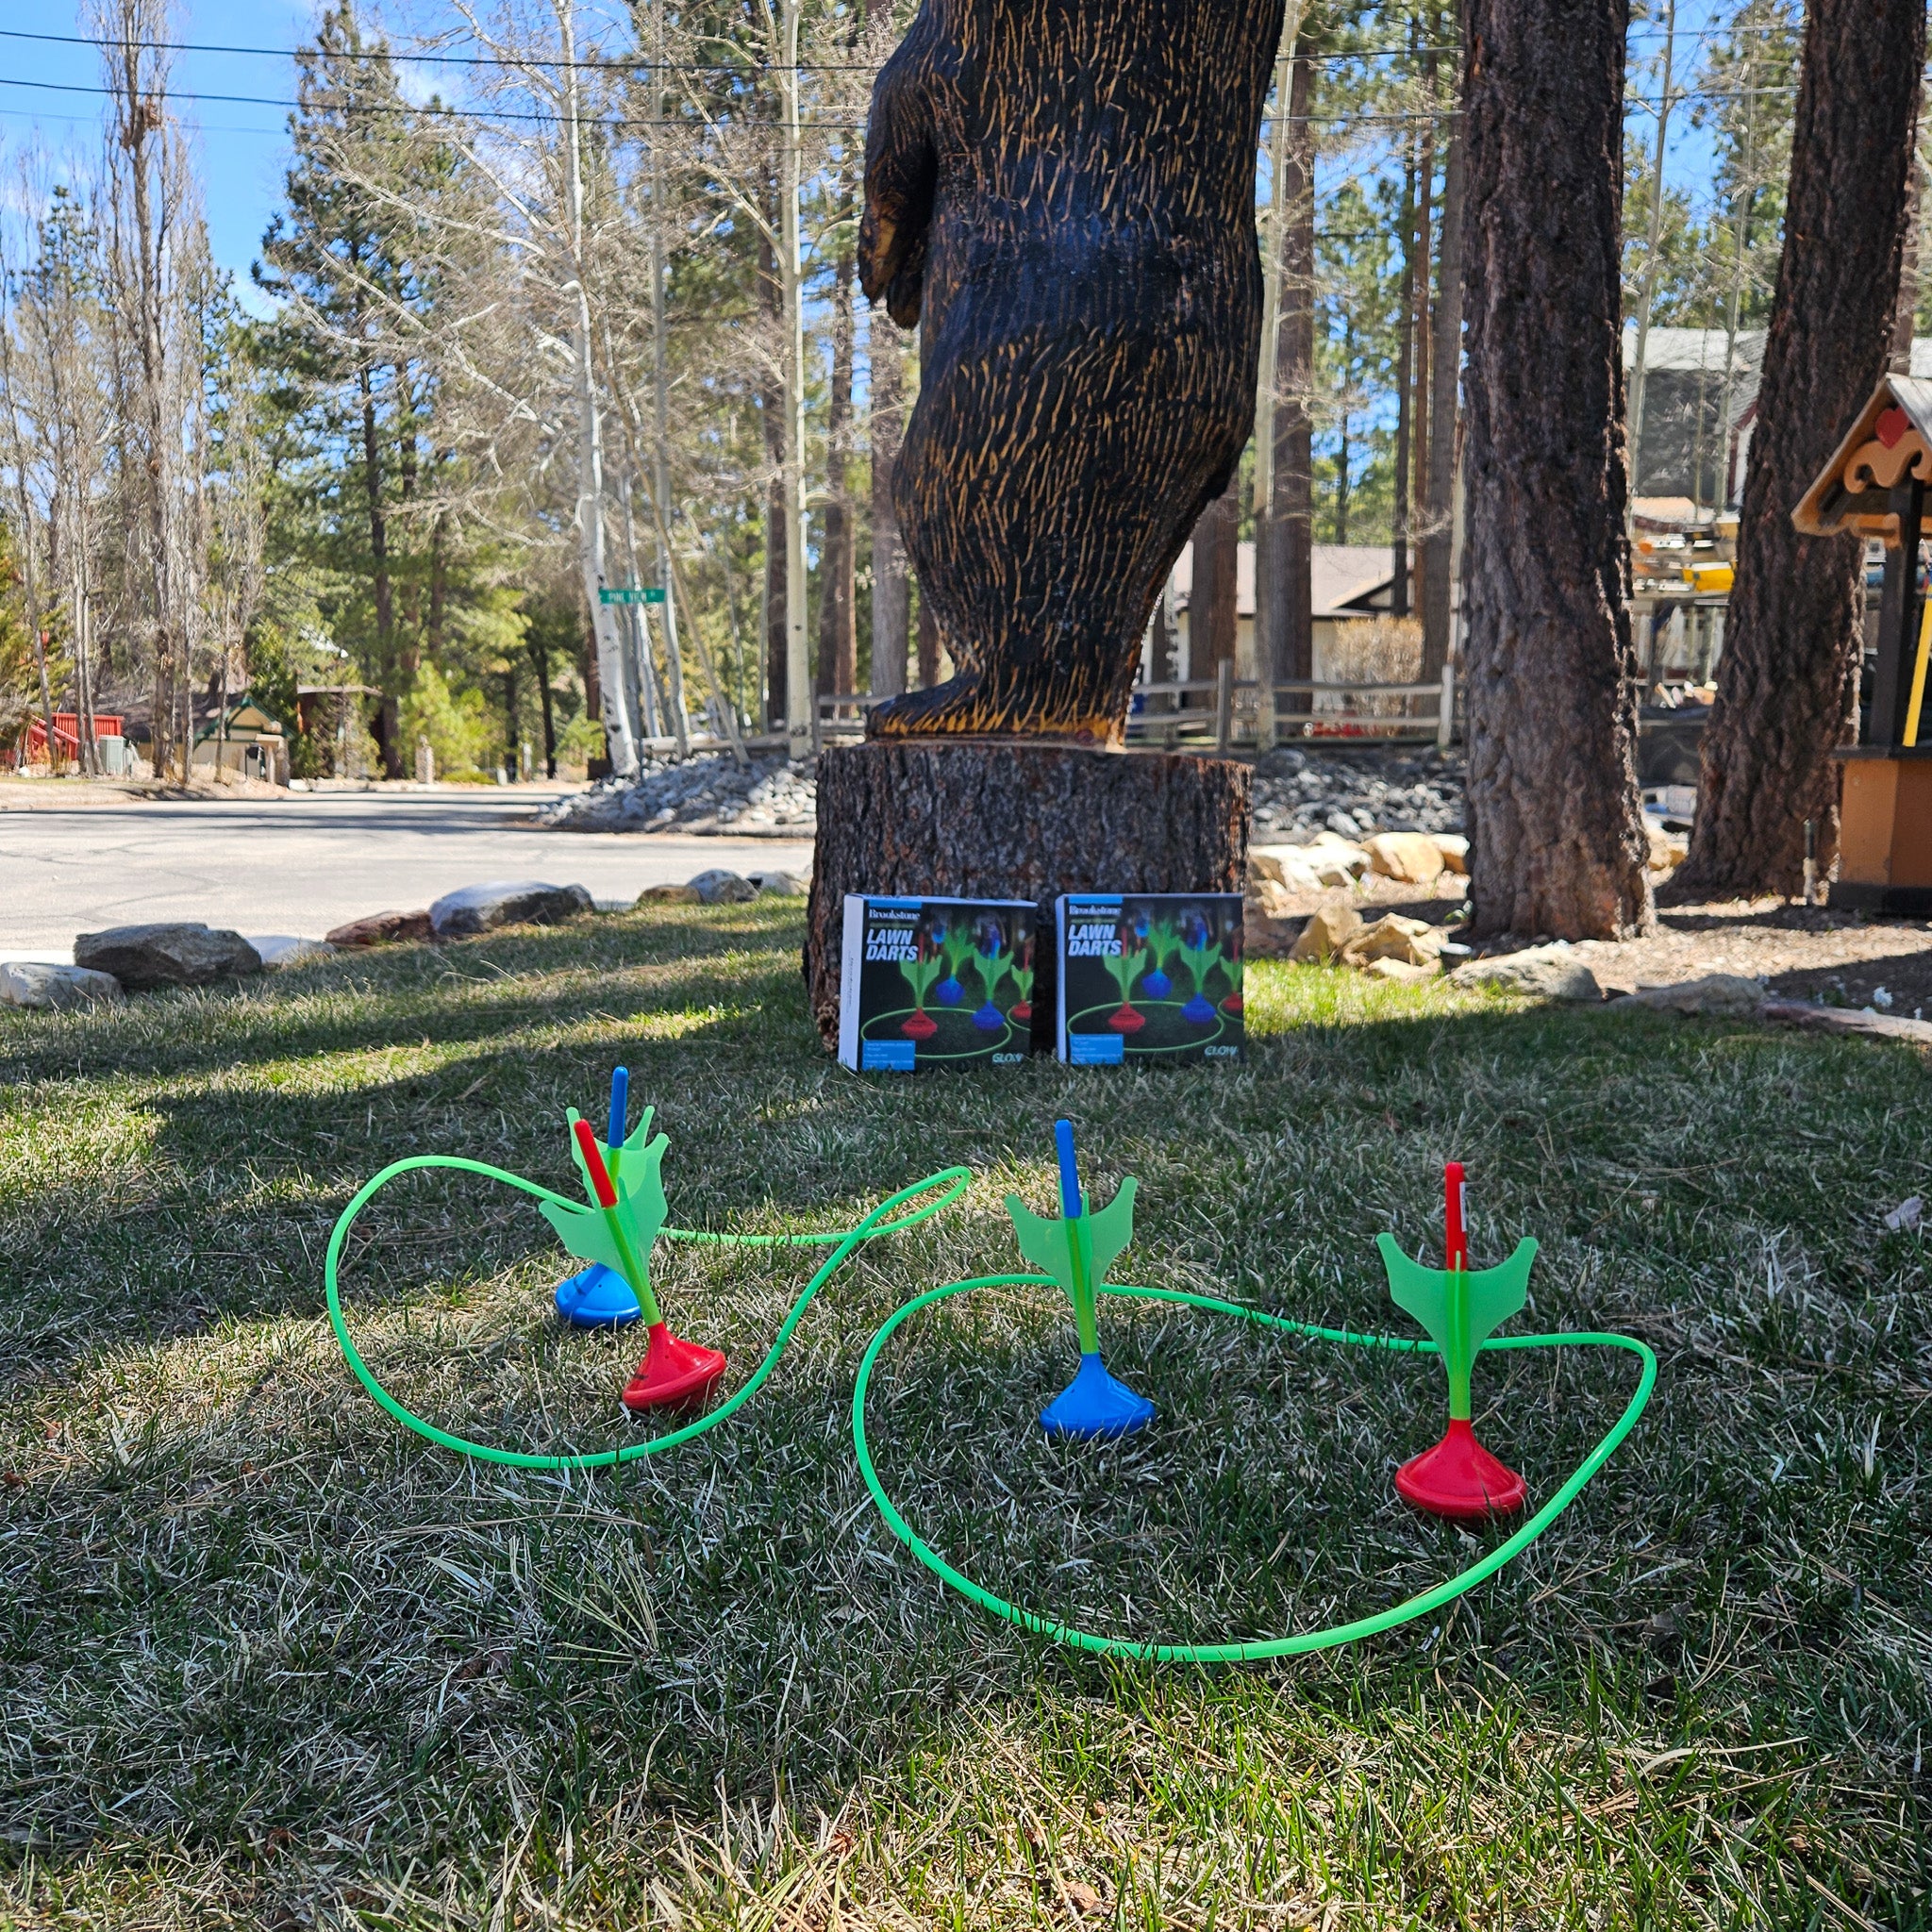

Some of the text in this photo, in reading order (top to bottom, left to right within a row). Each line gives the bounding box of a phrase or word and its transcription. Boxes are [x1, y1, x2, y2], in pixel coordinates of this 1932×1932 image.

[869, 909, 920, 920] Brookstone
[1069, 906, 1122, 915] Brookstone
[867, 929, 913, 944] LAWN
[1068, 924, 1115, 940] LAWN
[866, 945, 918, 960] DARTS
[1068, 941, 1122, 956] DARTS
[1205, 1046, 1238, 1056] GLOW
[992, 1053, 1023, 1063] GLOW
